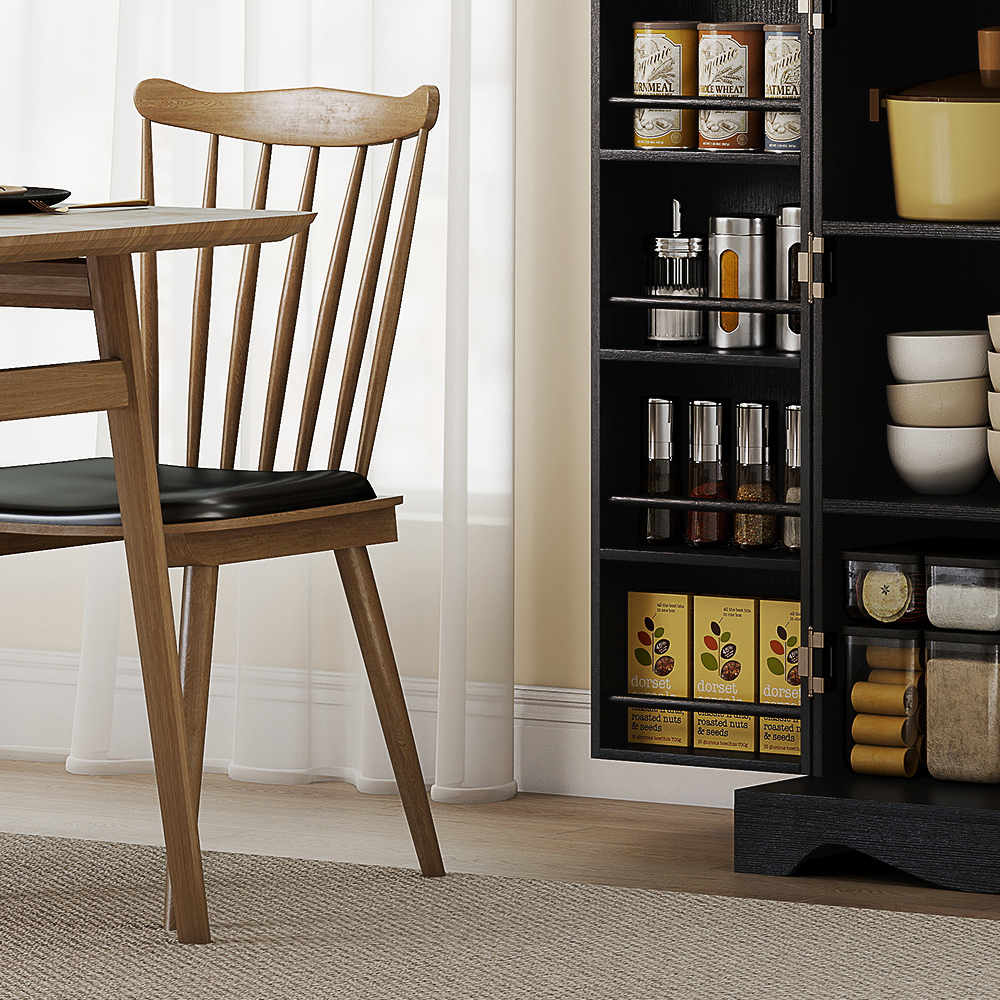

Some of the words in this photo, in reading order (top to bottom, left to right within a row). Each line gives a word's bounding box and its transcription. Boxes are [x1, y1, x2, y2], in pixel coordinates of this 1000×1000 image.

[715, 85, 745, 94] WHEAT
[631, 675, 672, 690] dorset
[697, 679, 738, 694] dorset
[631, 713, 661, 722] roasted
[662, 716, 682, 724] nuts
[631, 722, 638, 730] &
[639, 723, 663, 732] seeds
[697, 719, 728, 728] roasted
[729, 720, 749, 729] nuts
[764, 723, 794, 732] roasted
[697, 727, 705, 735] &
[706, 728, 729, 737] seeds
[764, 732, 771, 740] &
[772, 733, 795, 742] seeds
